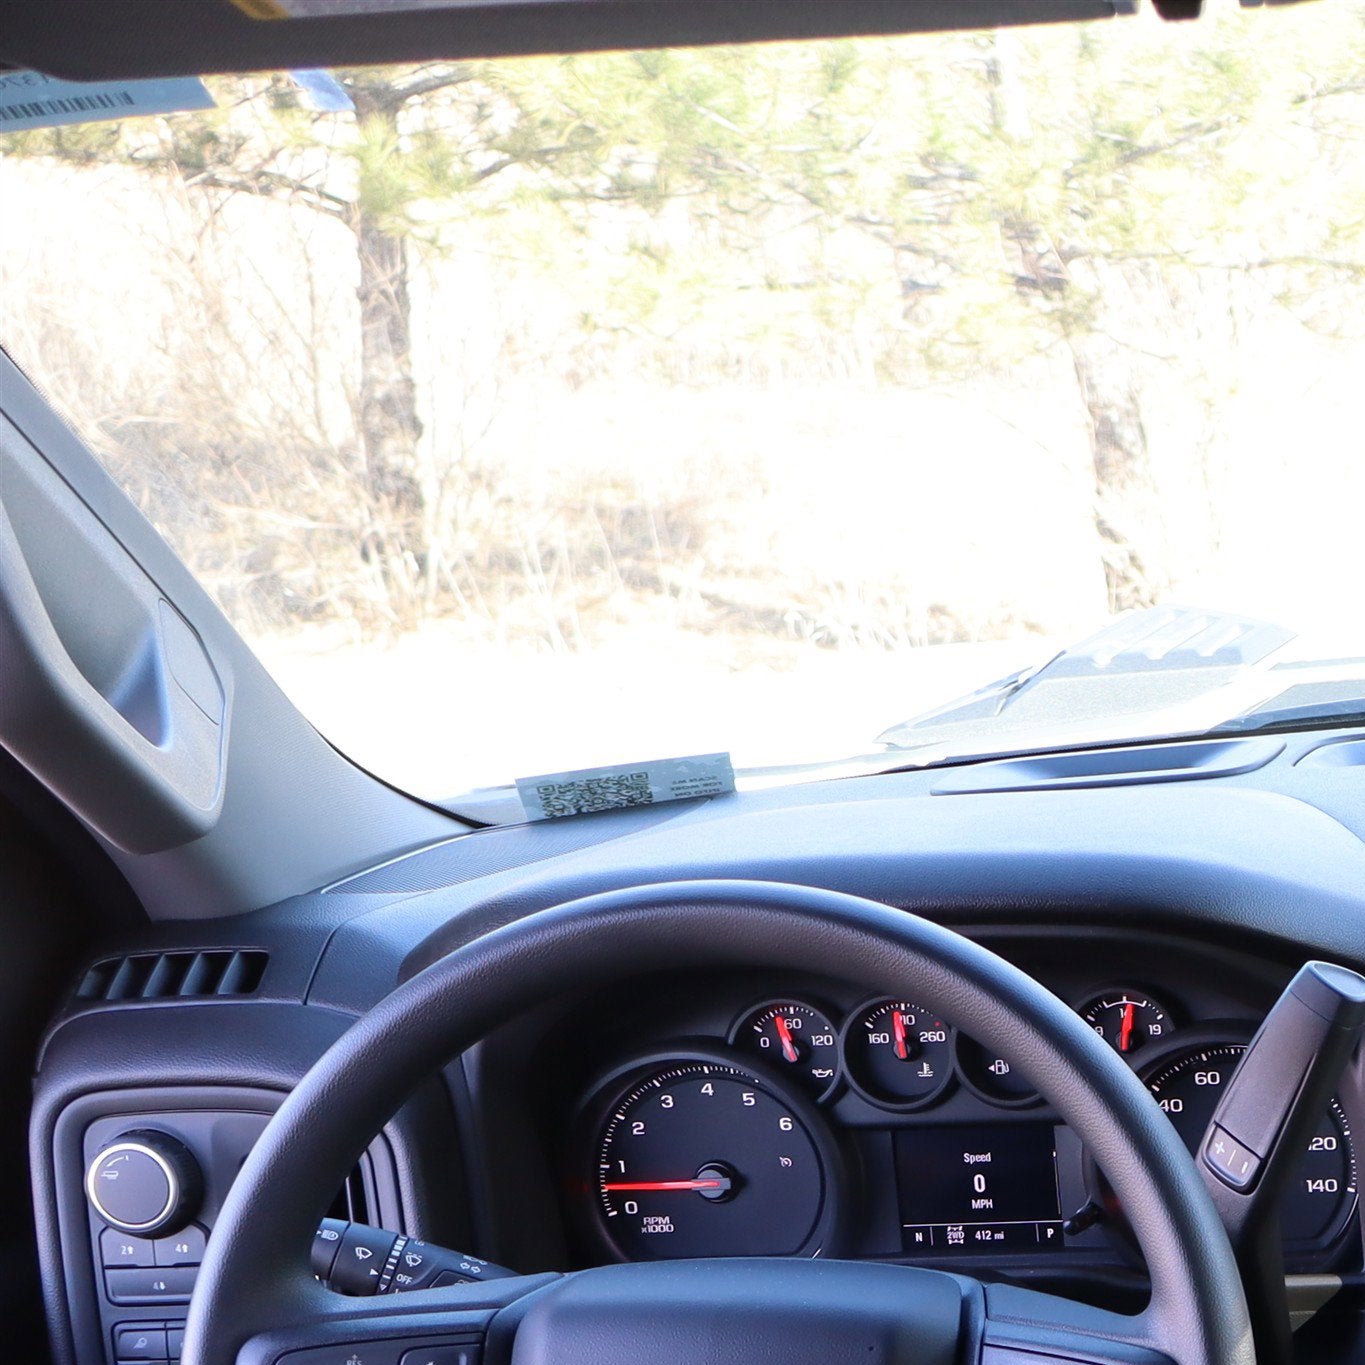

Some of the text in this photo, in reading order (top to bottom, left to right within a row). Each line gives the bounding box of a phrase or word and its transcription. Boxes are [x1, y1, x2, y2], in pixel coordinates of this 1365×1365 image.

[784, 1018, 802, 1030] 60
[1149, 1024, 1162, 1036] 19
[811, 1034, 833, 1046] 120
[868, 1032, 890, 1044] 160
[919, 1030, 946, 1042] 260
[760, 1037, 770, 1048] 0
[1194, 1071, 1220, 1085] 60
[701, 1083, 714, 1096] 4
[660, 1095, 674, 1109] 3
[742, 1093, 756, 1106] 5
[632, 1121, 645, 1135] 2
[779, 1117, 793, 1131] 6
[963, 1152, 992, 1165] Speed
[618, 1160, 626, 1173] 1
[973, 1173, 986, 1193] 0
[1306, 1179, 1338, 1193] 140
[624, 1201, 638, 1214] 0
[971, 1199, 993, 1209] MPH
[643, 1216, 670, 1225] RPM
[641, 1224, 674, 1233] x1000
[1046, 1228, 1054, 1239] P
[915, 1232, 923, 1242] N
[975, 1230, 1005, 1241] 412 mi
[396, 1273, 413, 1285] OFF
